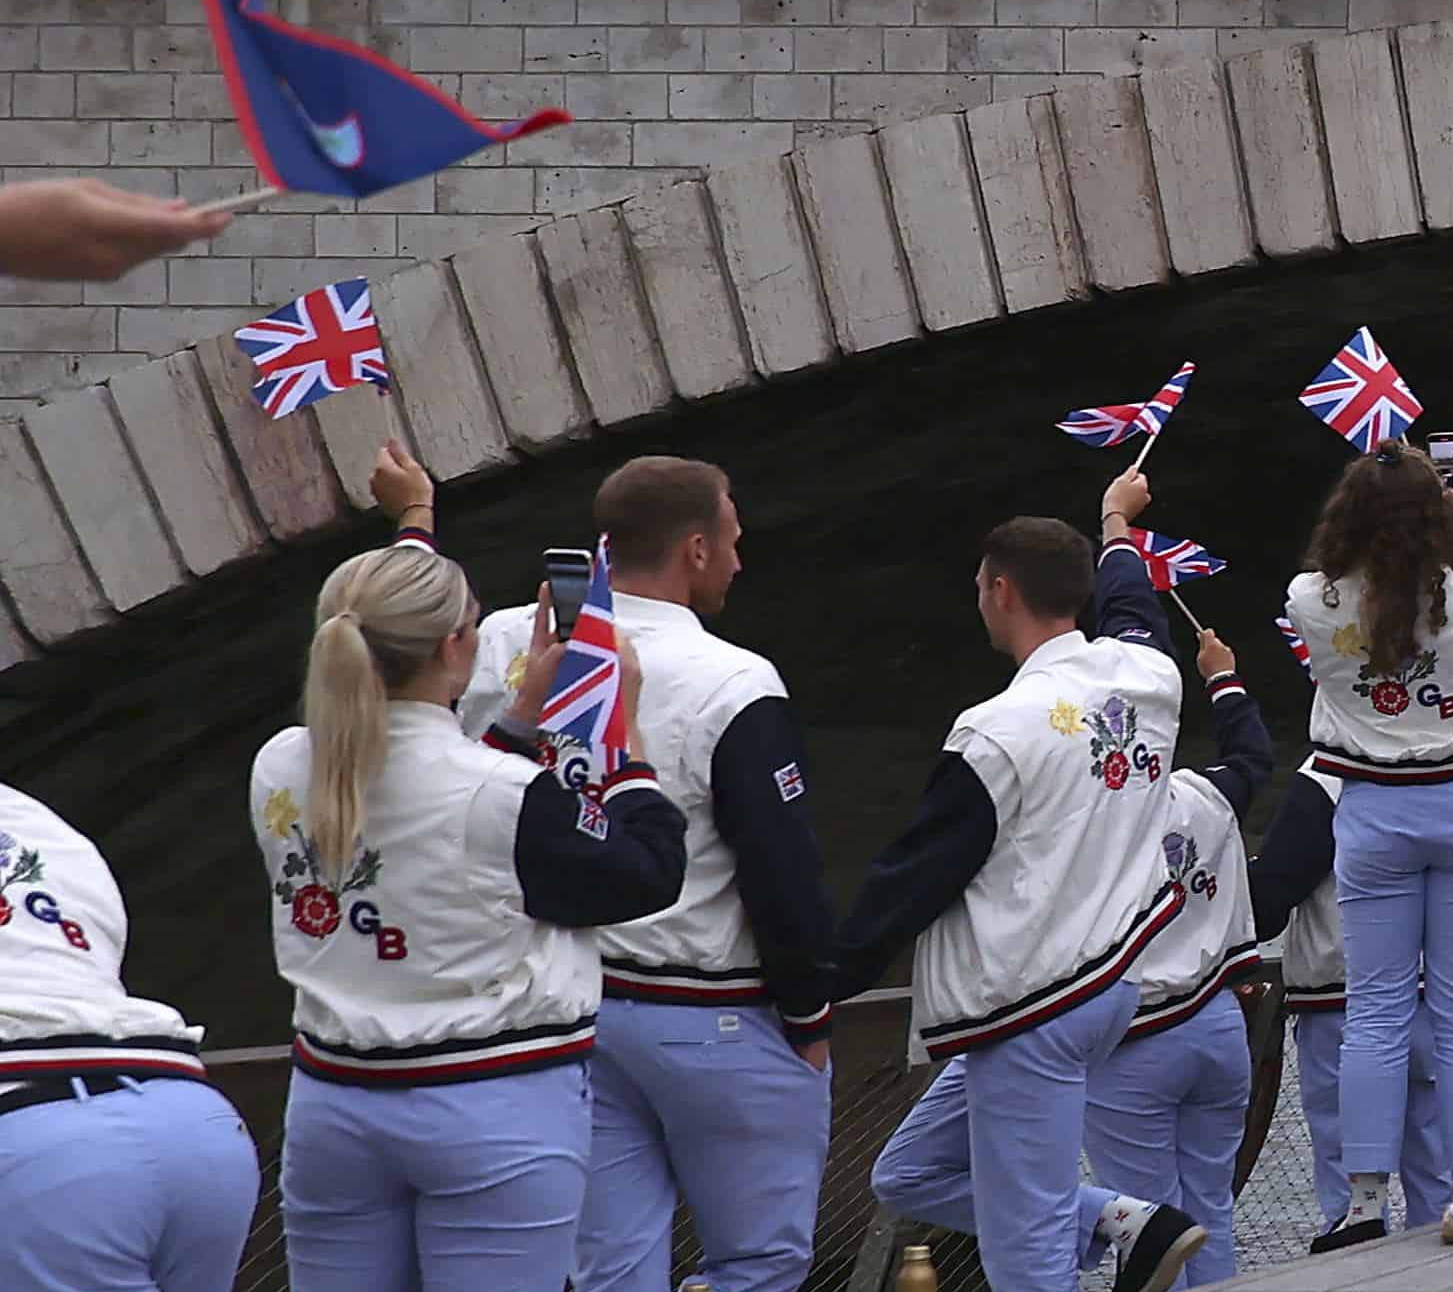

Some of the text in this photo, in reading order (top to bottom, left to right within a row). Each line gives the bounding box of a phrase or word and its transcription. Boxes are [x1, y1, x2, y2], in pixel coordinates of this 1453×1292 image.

[1132, 743, 1161, 783] GB
[1190, 870, 1218, 901] GB
[24, 891, 91, 951] GB
[348, 901, 409, 961] GB
